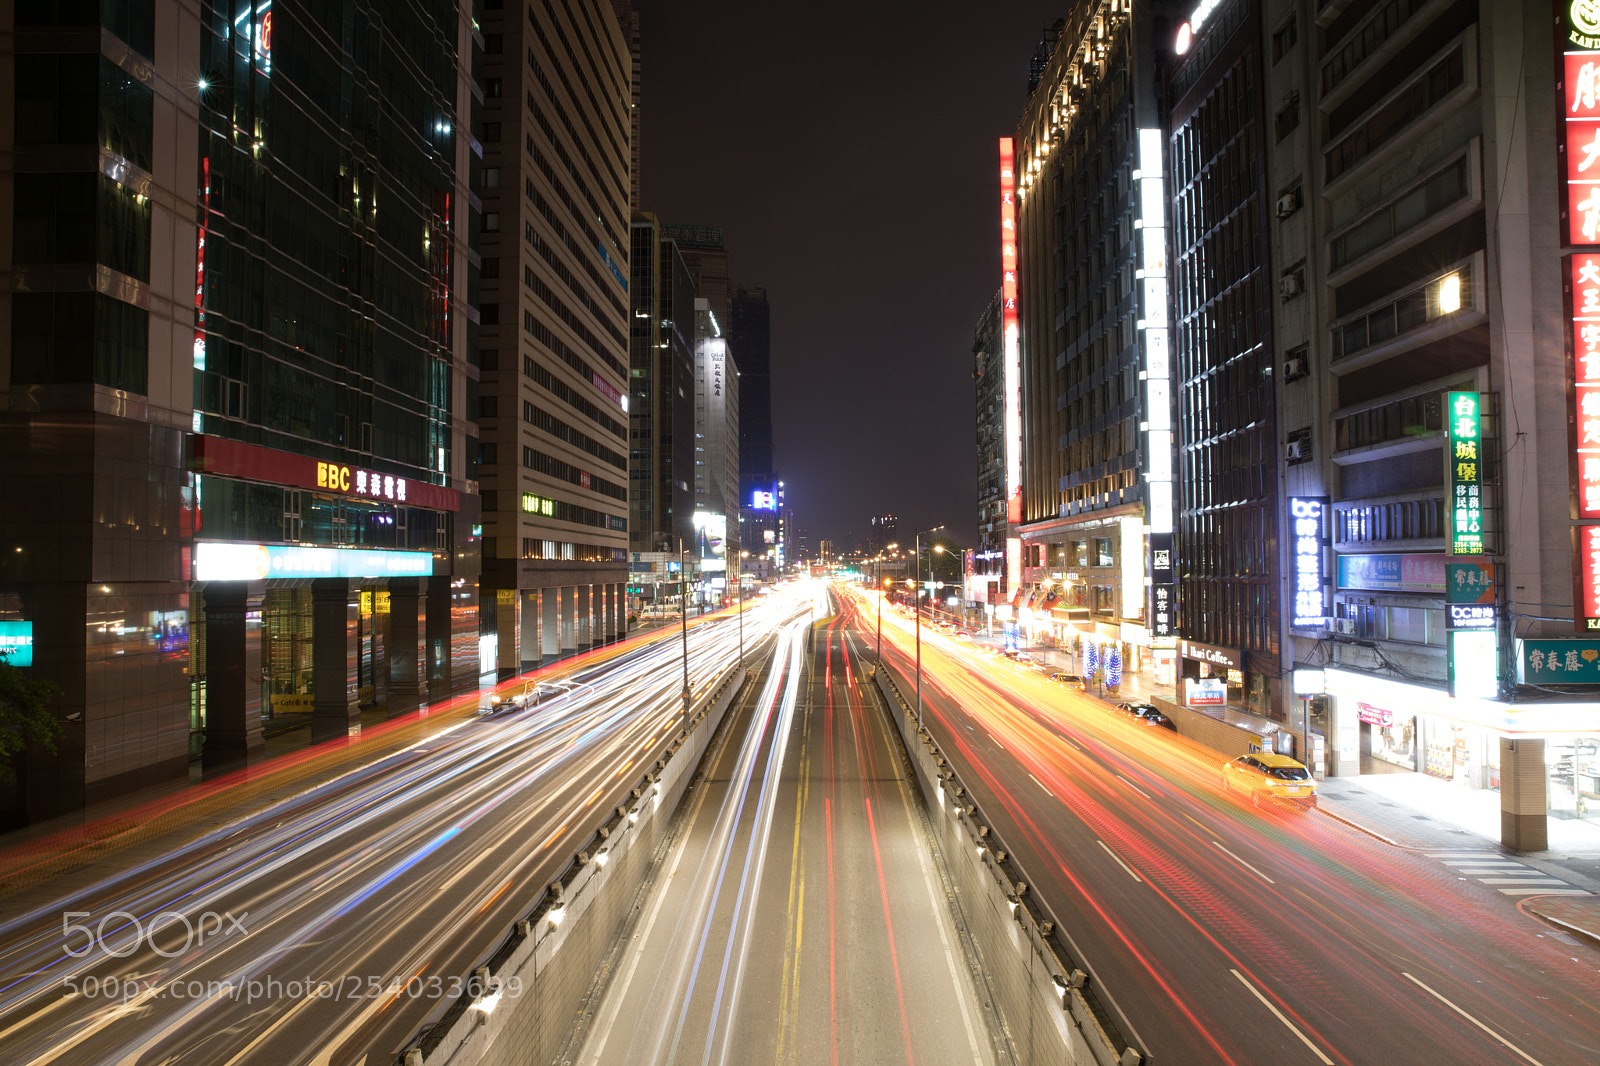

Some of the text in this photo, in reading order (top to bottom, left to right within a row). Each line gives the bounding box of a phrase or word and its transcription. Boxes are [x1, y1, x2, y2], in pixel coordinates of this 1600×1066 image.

[1454, 395, 1477, 482] 台北城堡
[317, 461, 350, 491] EBC
[356, 470, 406, 501] 東森電視
[1292, 498, 1320, 517] bc
[1468, 484, 1480, 533] 商務中心
[1455, 569, 1492, 587] 常春藤
[1157, 588, 1168, 635] 怡客咖啡
[1206, 649, 1228, 665] Coffee
[1529, 649, 1583, 673] 常春藤
